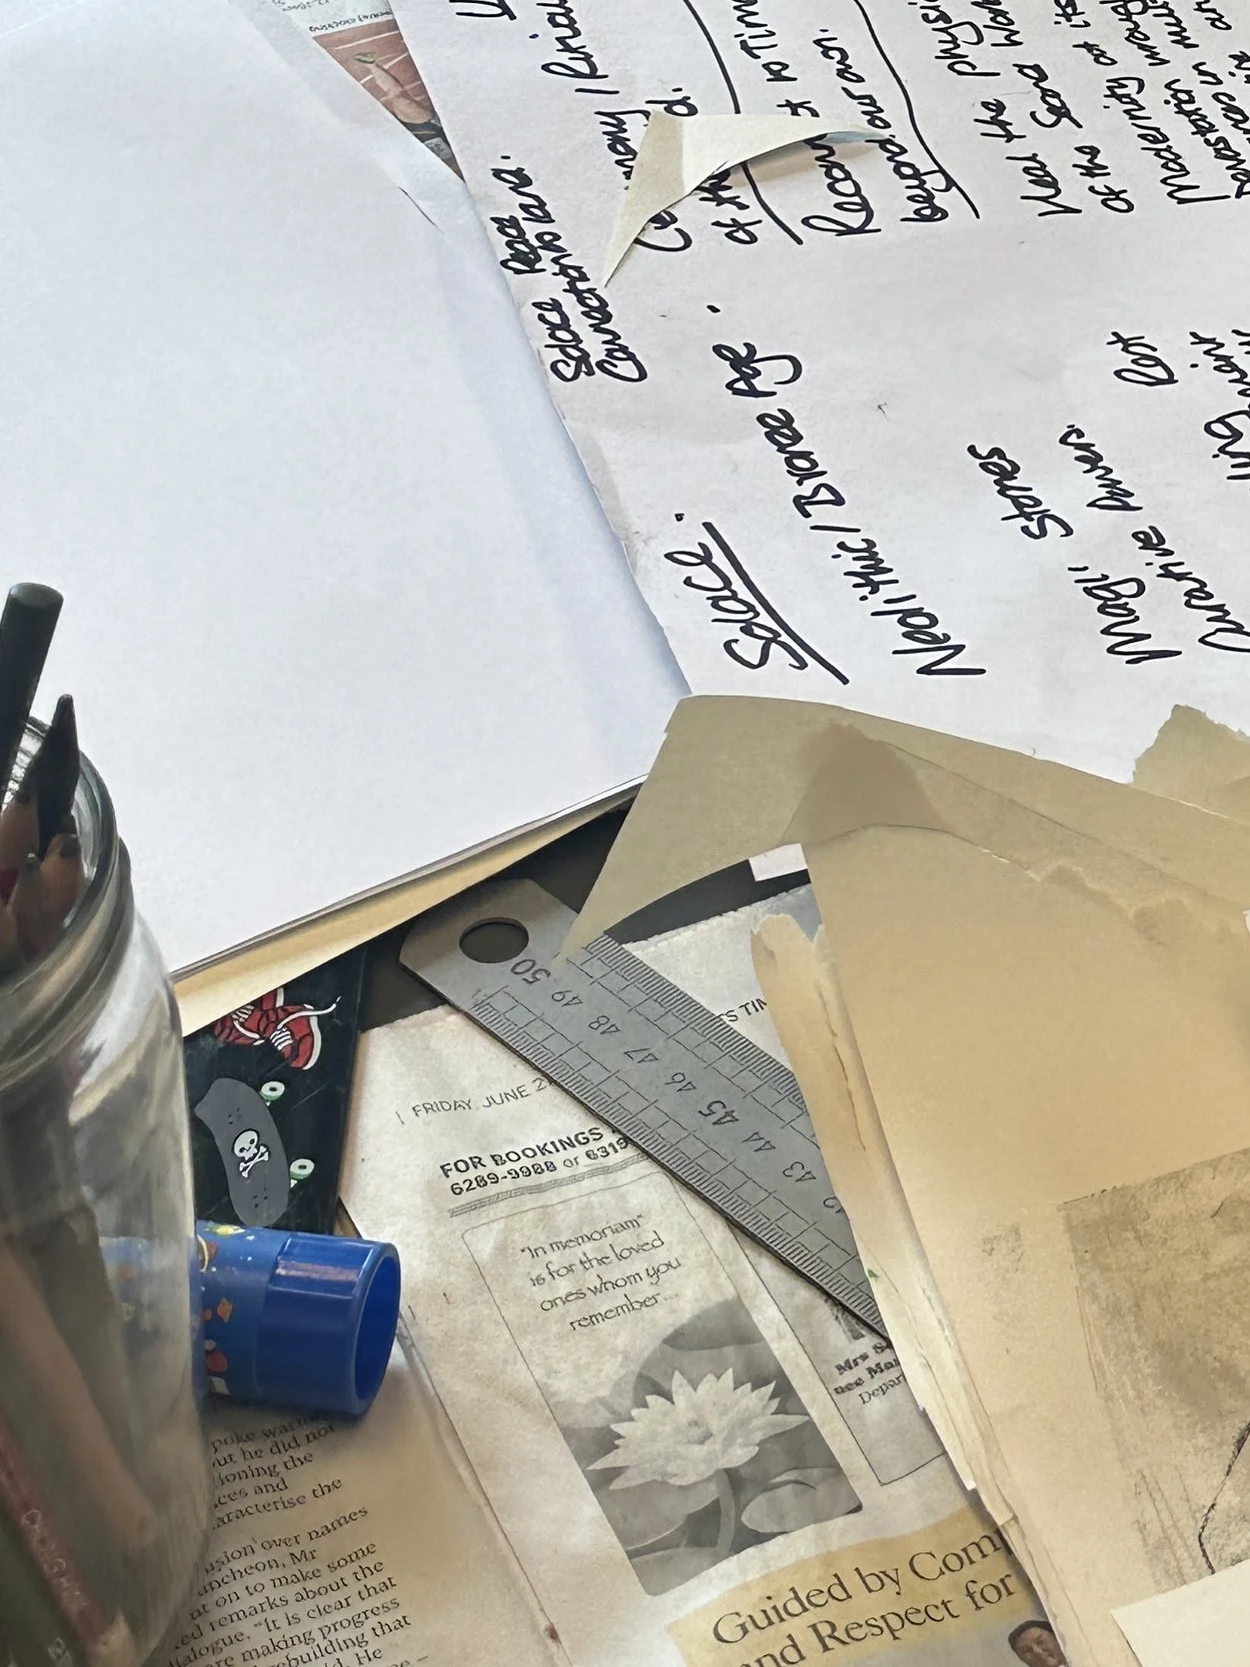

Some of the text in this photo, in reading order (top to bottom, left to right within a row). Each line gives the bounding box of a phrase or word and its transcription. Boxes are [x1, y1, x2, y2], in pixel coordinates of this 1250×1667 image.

[974, 97, 1027, 140] the
[1073, 144, 1111, 179] the
[510, 958, 551, 985] 50
[551, 987, 584, 1010] 49
[588, 1013, 622, 1037] 48
[625, 1044, 658, 1066] 47
[671, 1070, 699, 1095] 46
[483, 1086, 530, 1110] JUNE
[698, 1099, 740, 1129] 45
[440, 1124, 603, 1178] FOR BOOKINGS
[744, 1130, 776, 1154] 44
[563, 1154, 581, 1171] or
[547, 1256, 578, 1285] for
[579, 1254, 610, 1276] the
[612, 1231, 664, 1263] loved
[541, 1258, 682, 1314] ones whom you
[269, 1433, 301, 1454] did
[283, 1451, 313, 1470] the
[253, 1478, 288, 1496] and
[212, 1478, 343, 1530] aracterise the
[260, 1507, 368, 1552] over names
[289, 1549, 317, 1566] Mr
[215, 1542, 377, 1608] on to make some
[209, 1595, 289, 1632] remarks
[294, 1577, 348, 1602] about
[352, 1560, 384, 1581] the
[306, 1596, 352, 1620] clear
[357, 1575, 397, 1602] that
[711, 1560, 904, 1646] Guided by
[370, 1613, 411, 1638] that
[817, 1572, 1014, 1656] Respect for
[241, 1631, 316, 1663] making
[318, 1596, 400, 1641] progress
[354, 1647, 383, 1666] He
